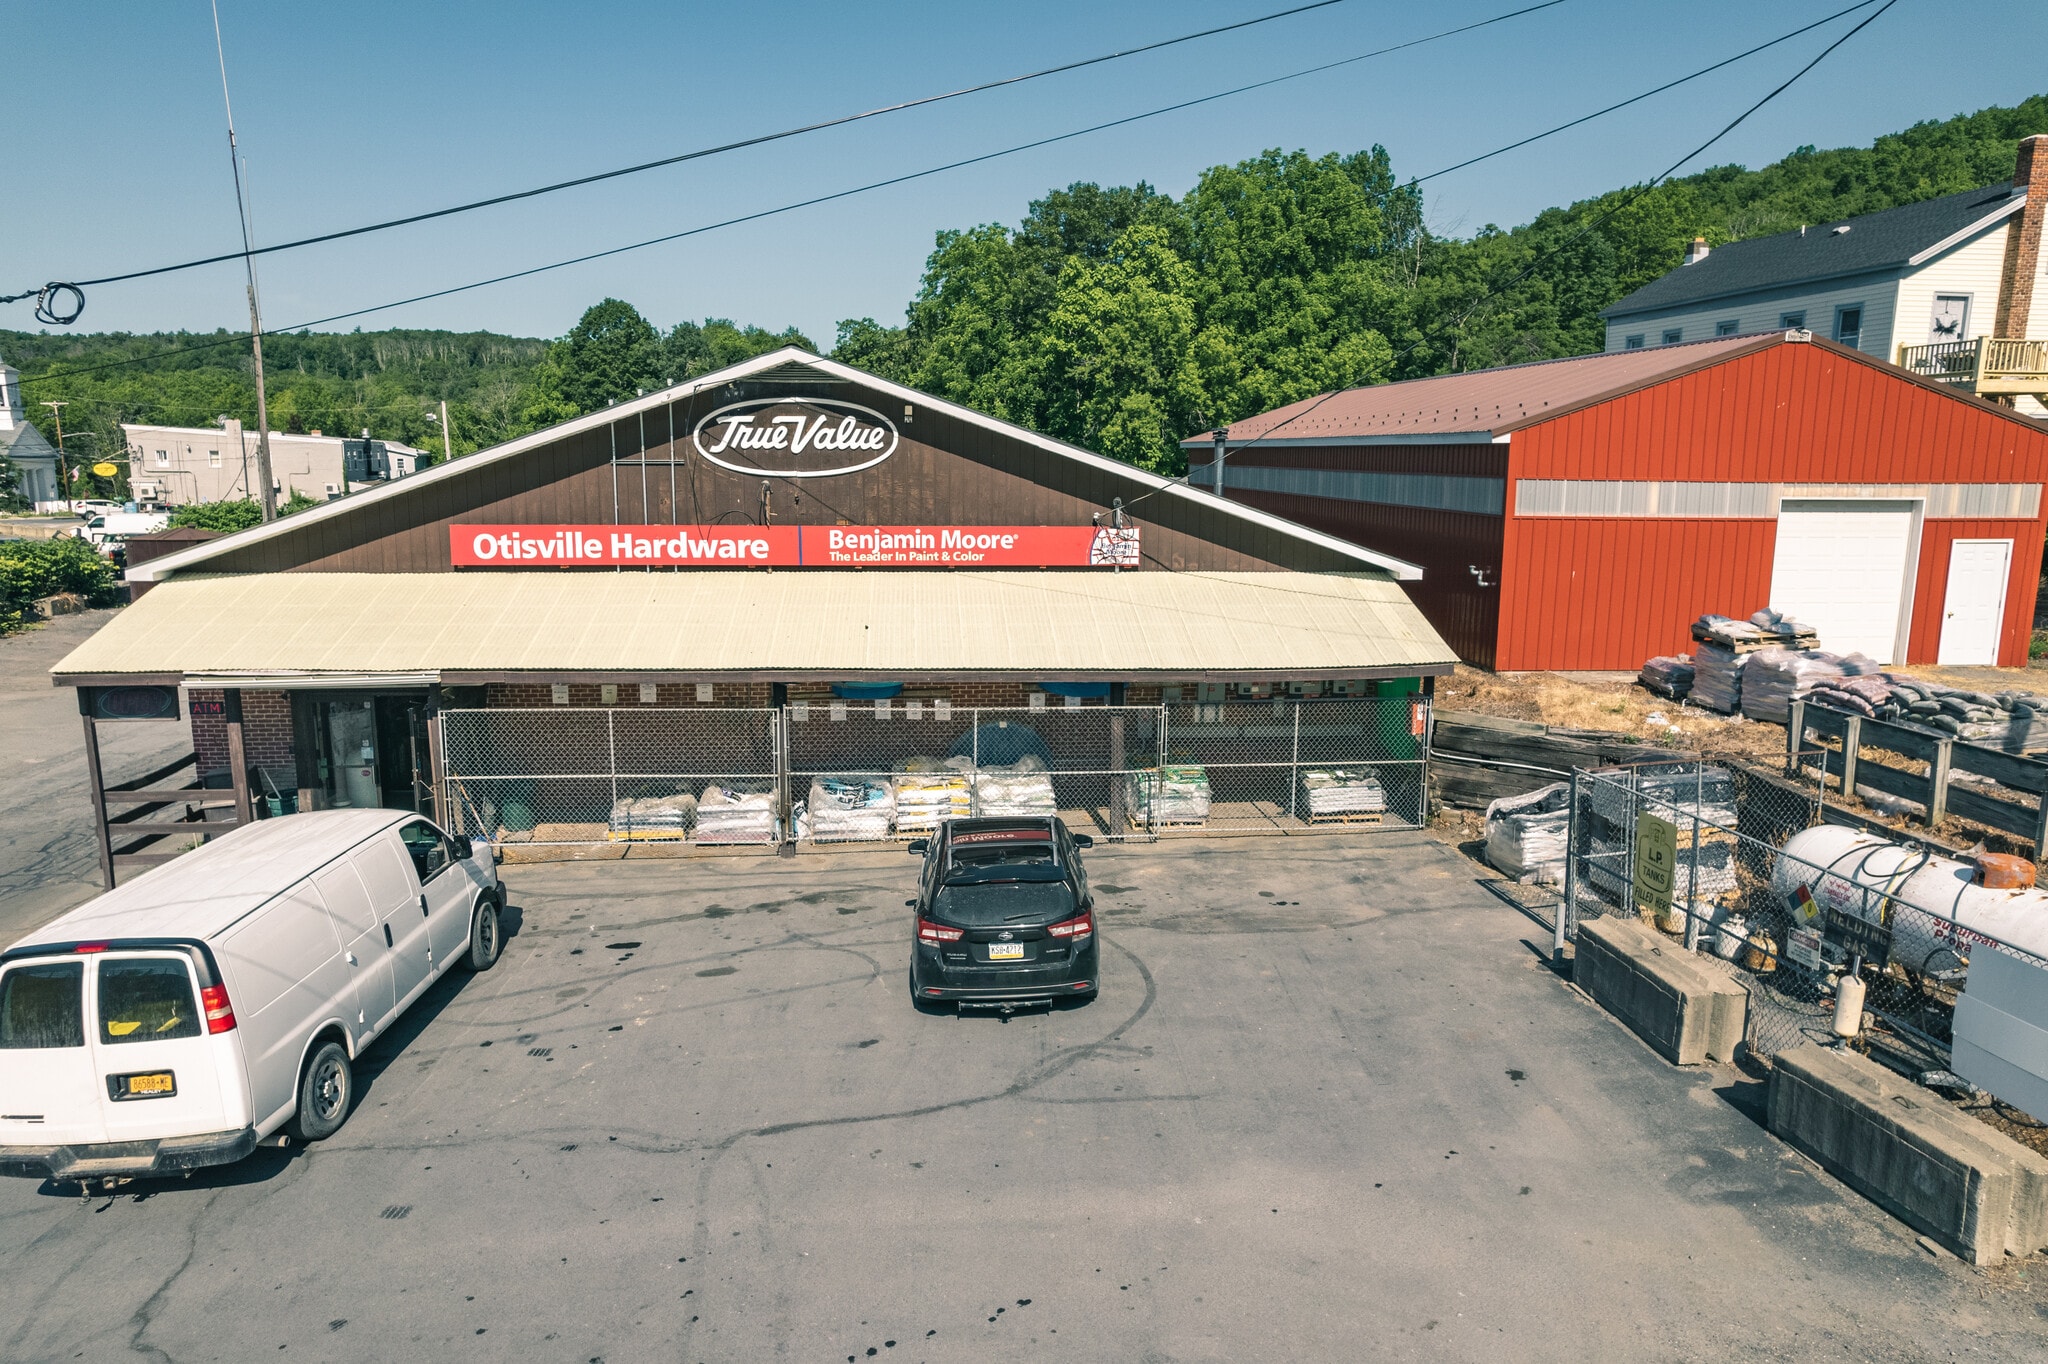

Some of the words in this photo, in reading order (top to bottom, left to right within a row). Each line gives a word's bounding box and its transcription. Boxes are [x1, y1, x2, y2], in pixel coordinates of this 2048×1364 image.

[473, 531, 602, 560] Otisville
[610, 532, 769, 559] Hardware
[829, 528, 935, 554] Benjamin
[829, 551, 850, 562] The
[853, 551, 893, 562] Leader
[895, 552, 906, 562] In
[909, 551, 939, 562] Paint
[941, 552, 951, 562] &
[953, 551, 985, 562] Color
[193, 703, 220, 713] ATM
[1648, 847, 1663, 865] L.P.
[1643, 865, 1664, 885] TANKS
[1635, 886, 1653, 904] FILLED
[1654, 897, 1671, 914] HERE
[1829, 909, 1888, 946] WELDING
[1843, 935, 1869, 957] GAS
[1934, 929, 1972, 953] Propa
